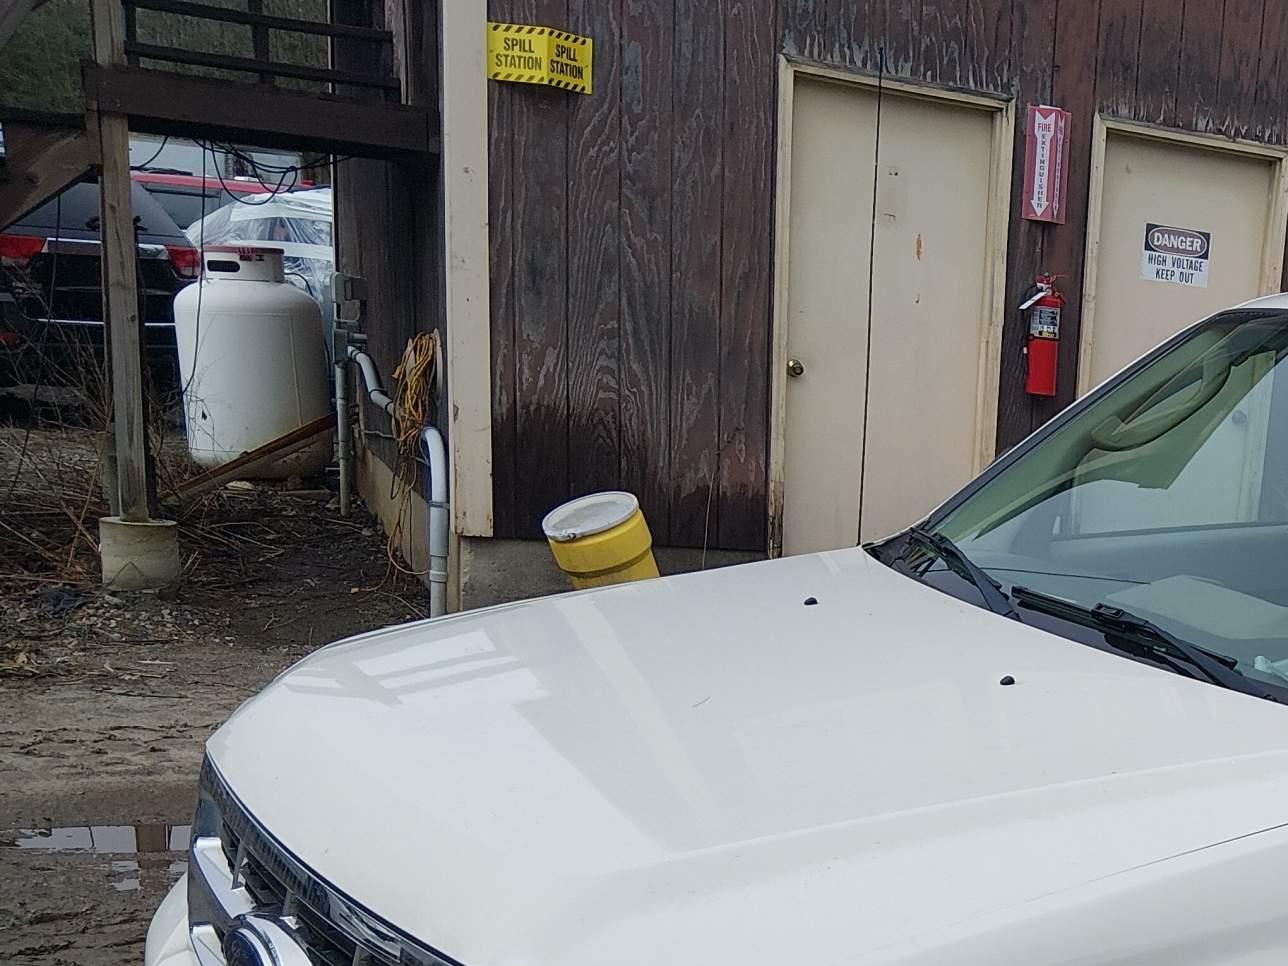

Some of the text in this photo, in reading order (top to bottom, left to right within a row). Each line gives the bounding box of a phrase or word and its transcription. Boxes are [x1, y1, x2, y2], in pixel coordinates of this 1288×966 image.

[503, 37, 534, 53] SPILL
[555, 43, 578, 62] SPILL
[495, 53, 542, 70] STATION
[550, 59, 584, 80] STATION
[1037, 122, 1052, 132] FIRE
[1153, 231, 1202, 252] DANGER
[1147, 253, 1204, 272] HIGH VOLTAGE
[1155, 267, 1194, 284] KEEP OUT
